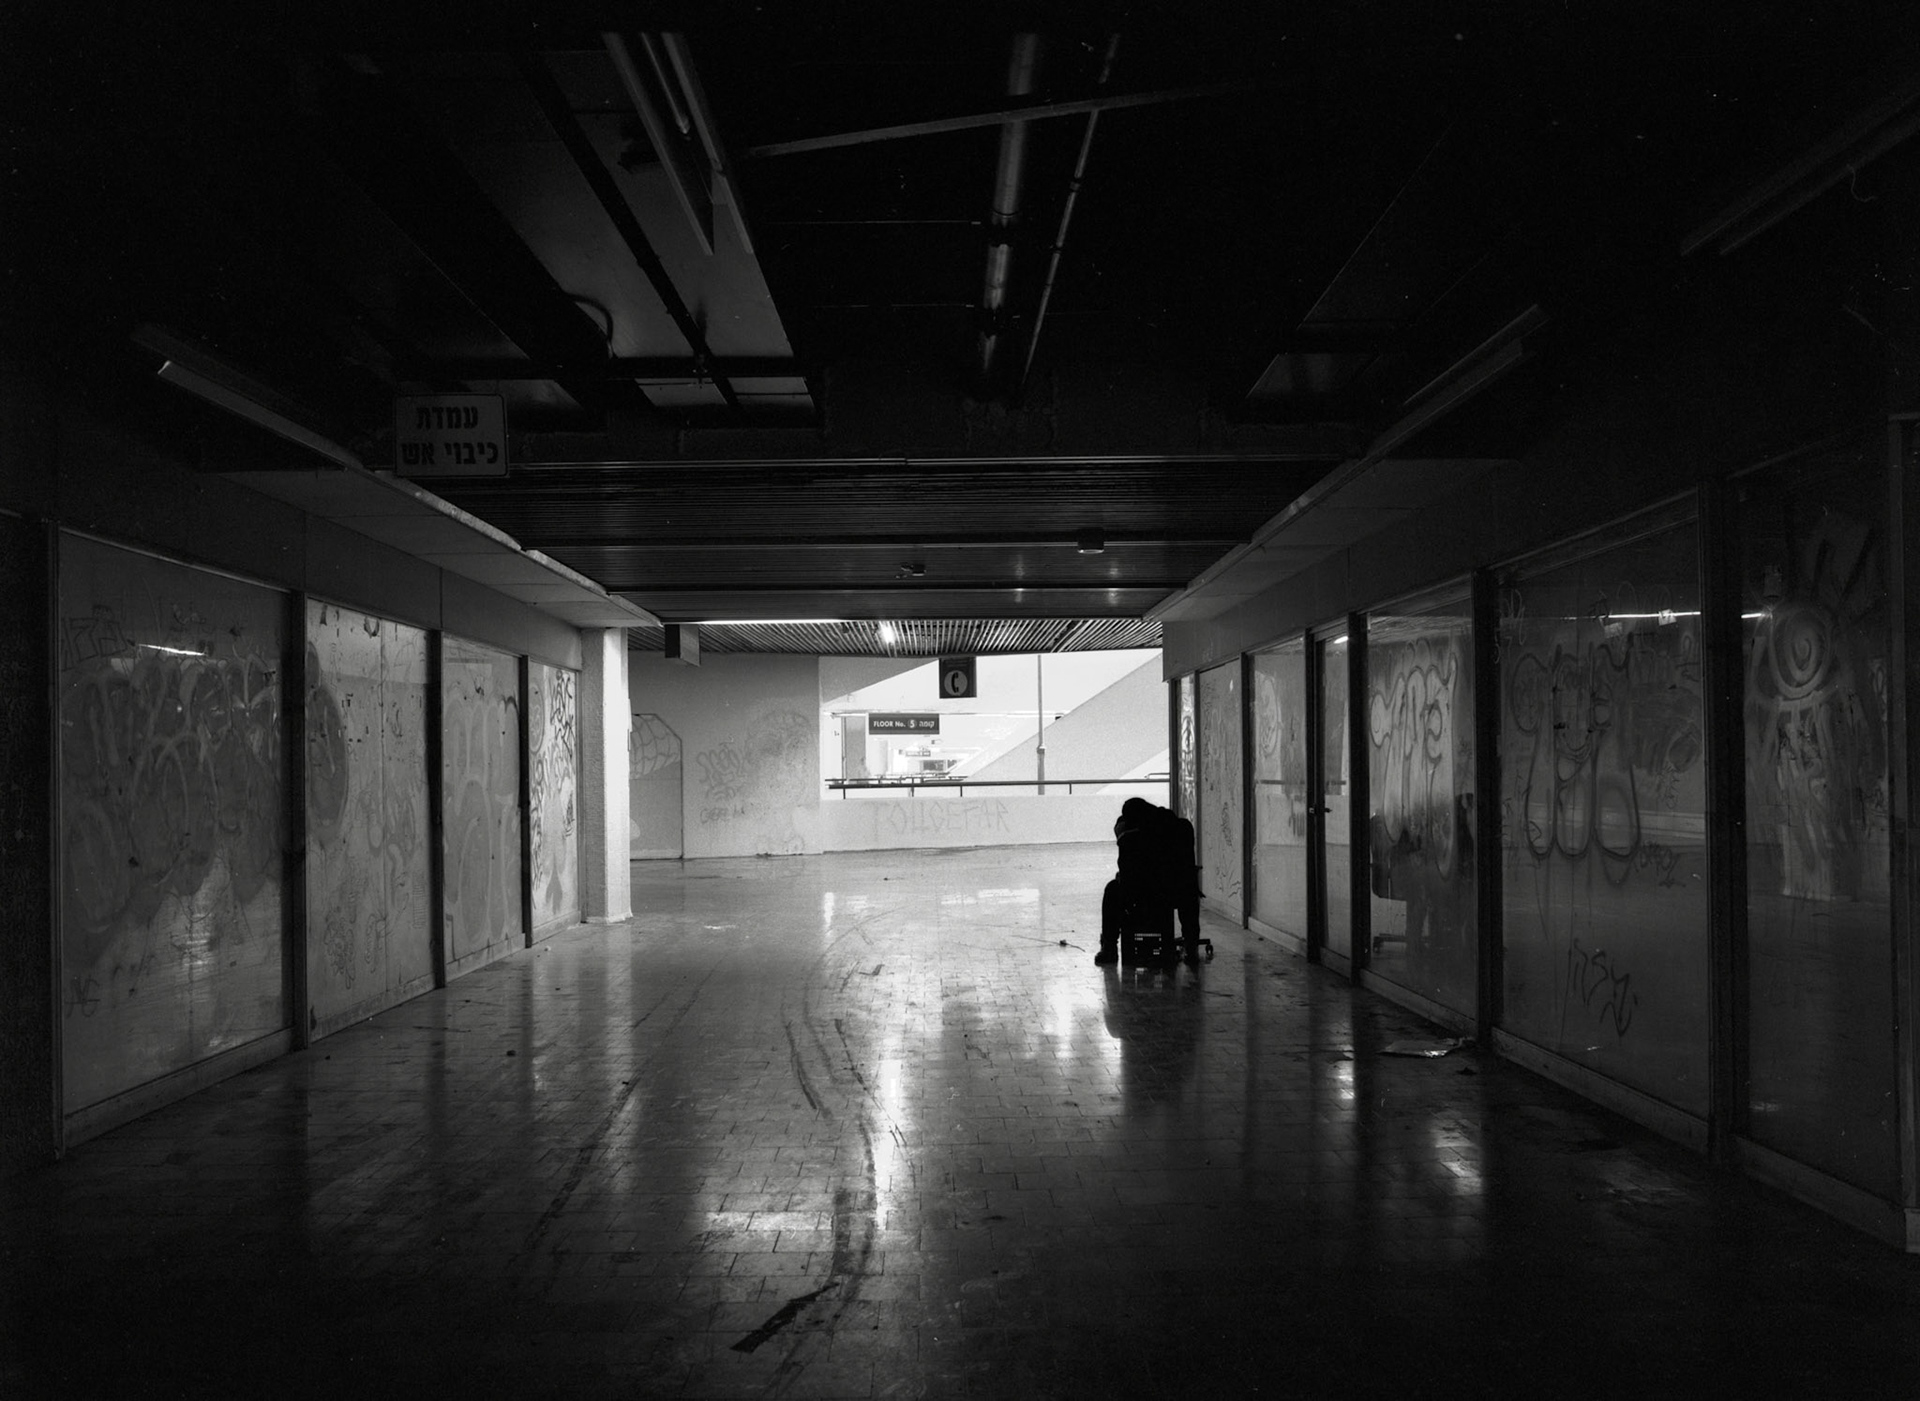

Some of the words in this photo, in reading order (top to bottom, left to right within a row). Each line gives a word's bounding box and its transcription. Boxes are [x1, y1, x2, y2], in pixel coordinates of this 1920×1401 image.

[416, 406, 478, 429] עמדת
[401, 441, 435, 466] אש
[444, 441, 498, 465] כיבוי
[873, 720, 894, 728] FLOOR
